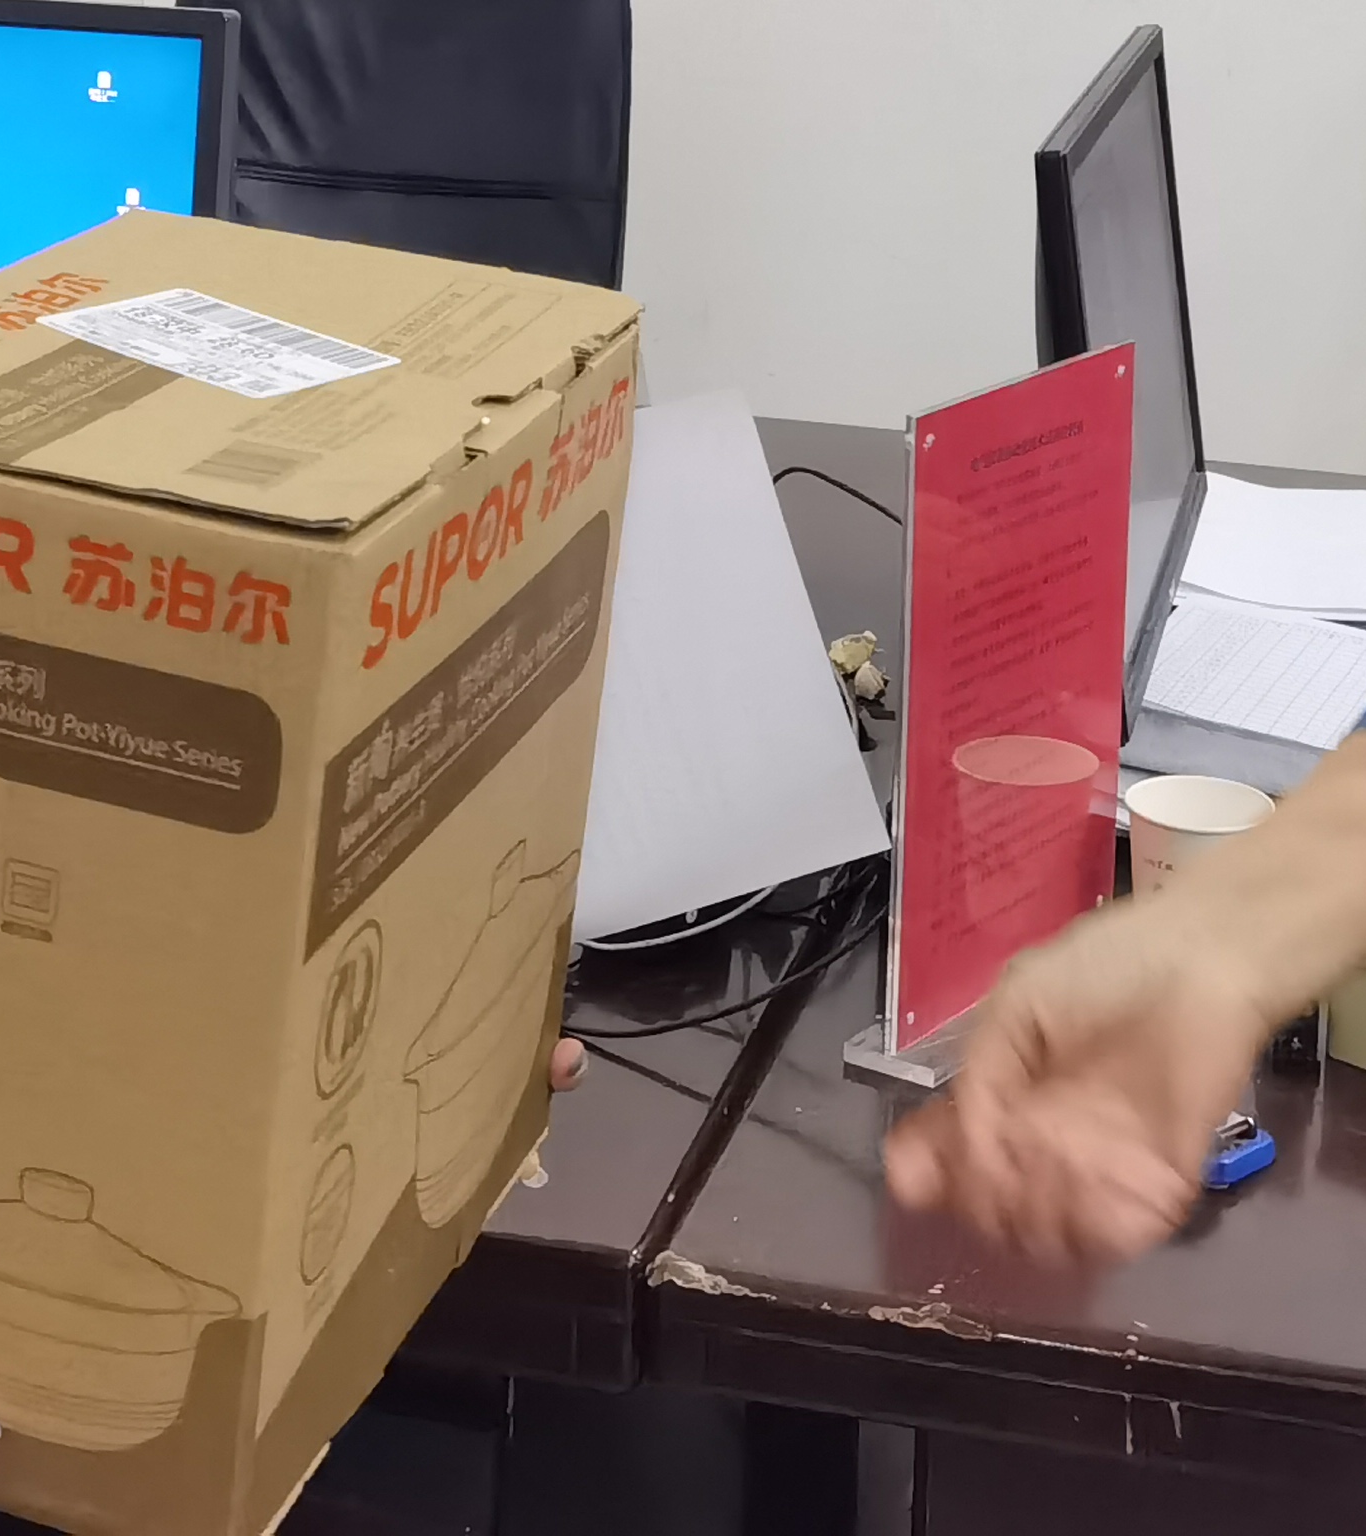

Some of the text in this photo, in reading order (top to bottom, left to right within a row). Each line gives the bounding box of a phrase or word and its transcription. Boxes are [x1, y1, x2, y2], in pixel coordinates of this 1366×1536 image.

[62, 534, 292, 646] 苏泊尔
[360, 458, 534, 670] SUPOR
[172, 739, 243, 778] Series
